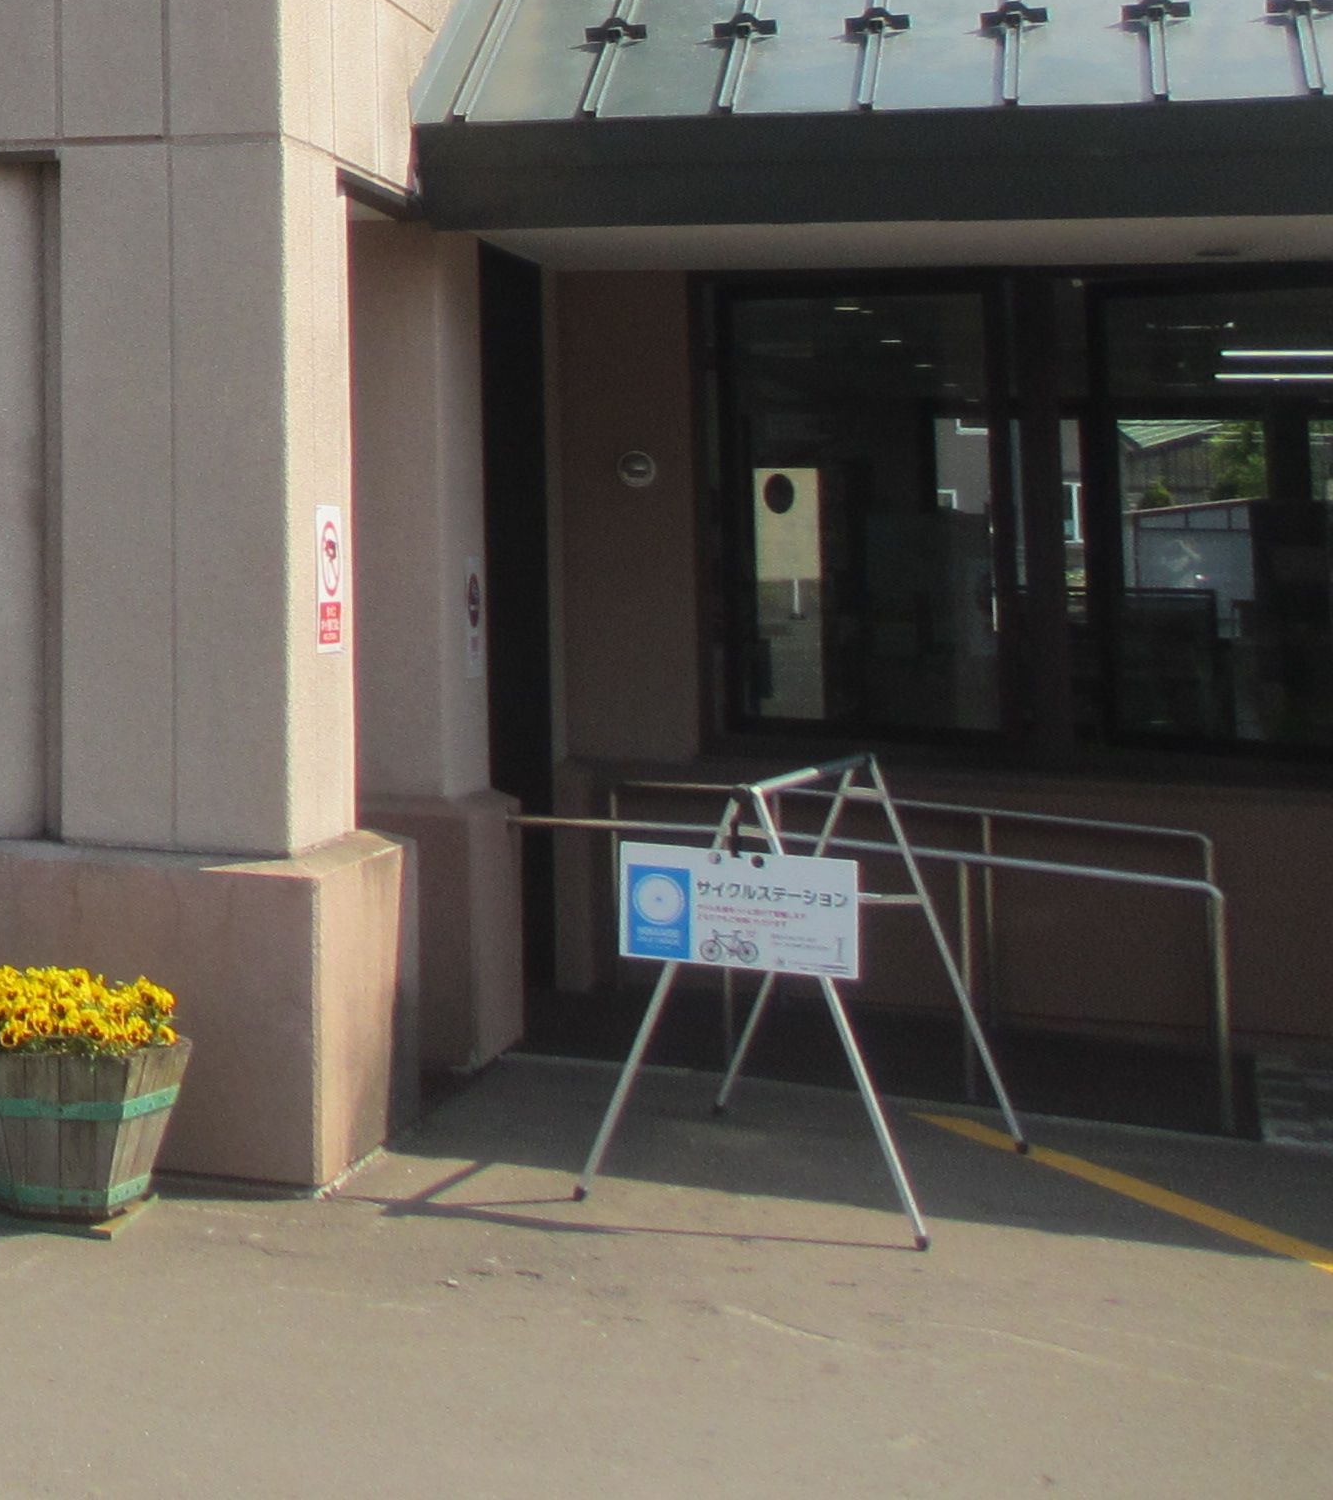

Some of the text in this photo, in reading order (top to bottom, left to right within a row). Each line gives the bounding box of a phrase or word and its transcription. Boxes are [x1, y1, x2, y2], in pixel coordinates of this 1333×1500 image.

[697, 880, 849, 908] サイクルステーション
